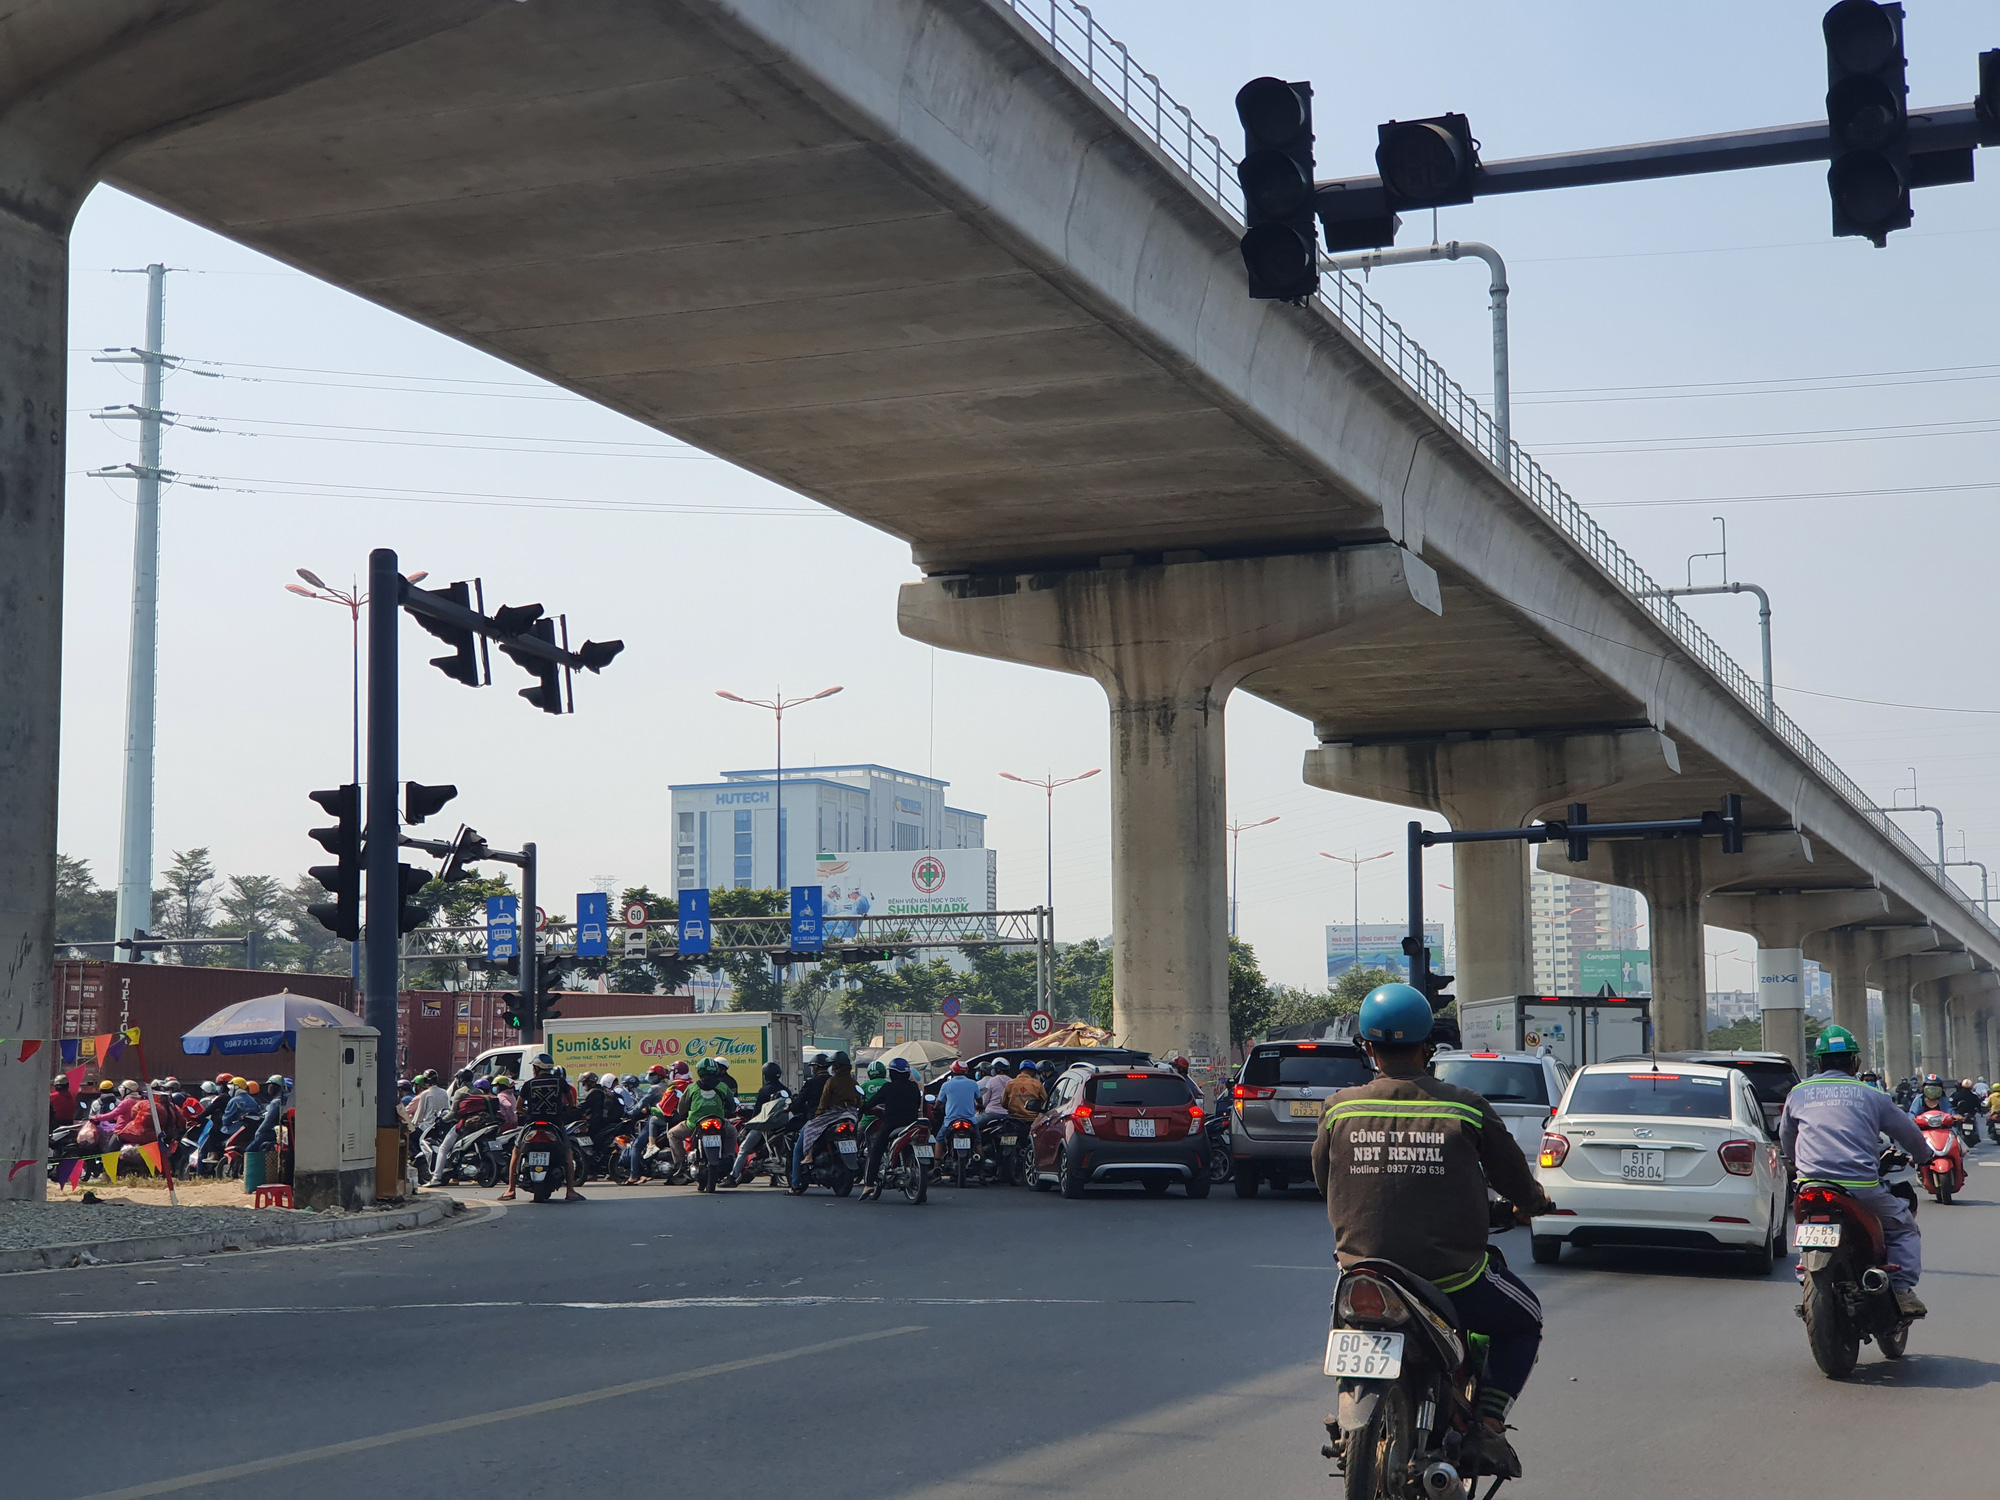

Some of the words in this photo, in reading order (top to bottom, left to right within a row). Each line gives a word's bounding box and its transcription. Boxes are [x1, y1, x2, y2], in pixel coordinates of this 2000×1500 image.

[716, 792, 769, 804] HUTECH
[631, 909, 641, 920] 60
[888, 904, 928, 914] SHING
[931, 903, 969, 913] MARK
[1761, 974, 1779, 983] zeit
[1034, 1018, 1047, 1030] 50
[224, 1038, 273, 1049] 0987.013.202
[556, 1036, 631, 1053] Sumi&Suki
[640, 1038, 680, 1058] GẠO
[1816, 1086, 1839, 1099] PHONG
[1840, 1086, 1865, 1100] RENTAL
[1135, 1120, 1149, 1128] 51H
[1350, 1129, 1385, 1144] CÔNG
[1389, 1132, 1405, 1143] TY
[1408, 1131, 1445, 1144] TNHH
[1354, 1147, 1381, 1161] NBT
[1388, 1147, 1444, 1162] RENTAL
[1632, 1152, 1654, 1165] 51F
[1350, 1165, 1379, 1175] Hotline
[1387, 1164, 1408, 1174] 0937
[1411, 1165, 1427, 1174] 729
[1429, 1165, 1445, 1175] 638
[1623, 1165, 1662, 1178] 968.04
[1804, 1226, 1834, 1236] 17-B3
[1340, 1335, 1392, 1355] 60-Z2
[1336, 1354, 1390, 1375] 5367
